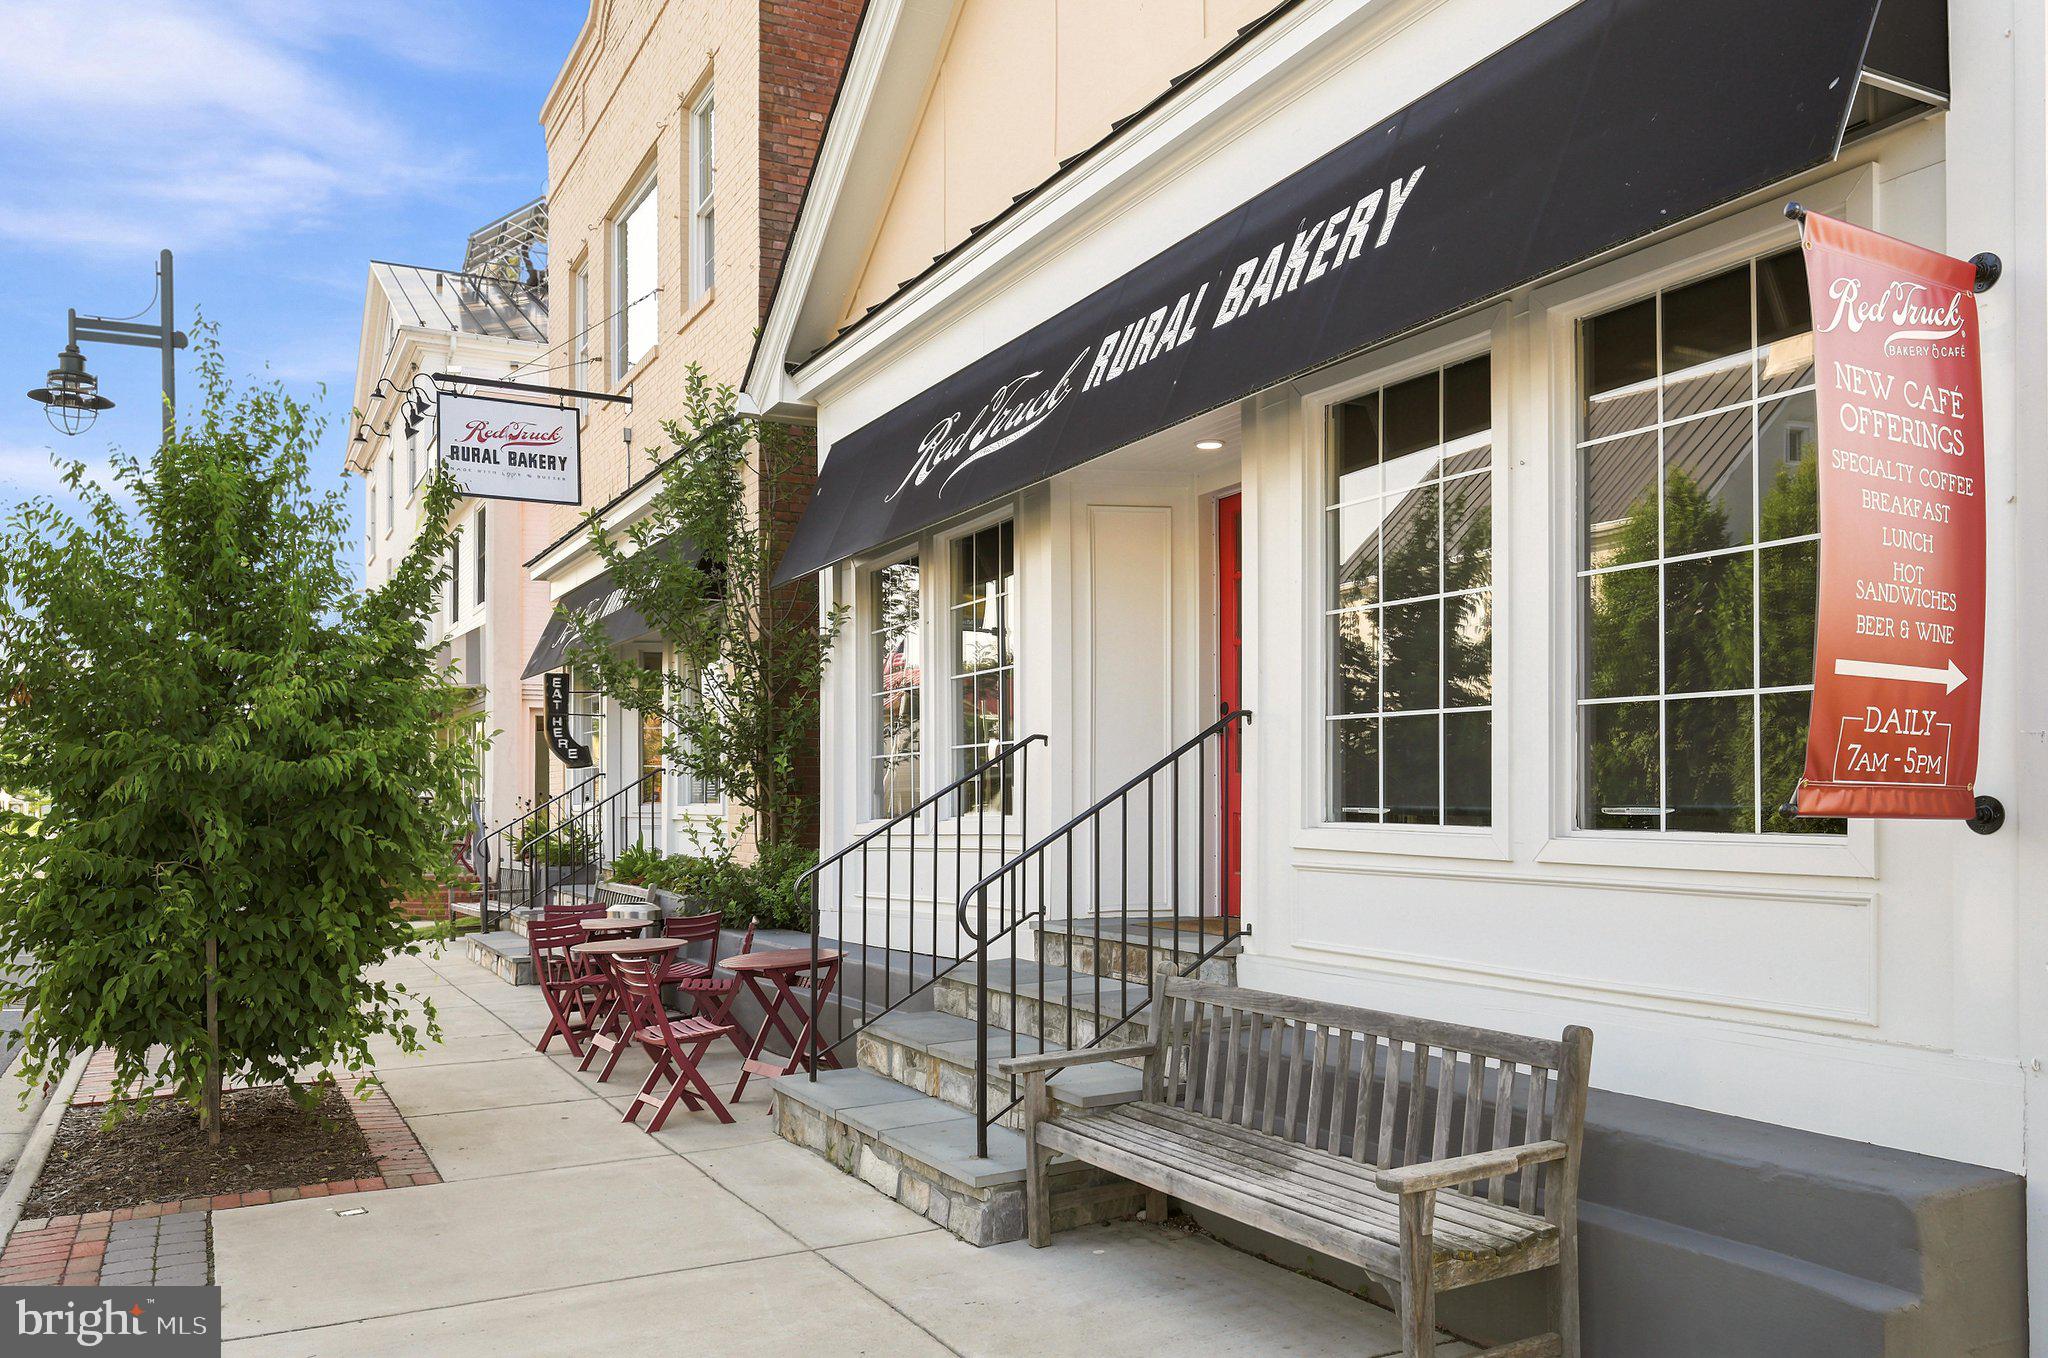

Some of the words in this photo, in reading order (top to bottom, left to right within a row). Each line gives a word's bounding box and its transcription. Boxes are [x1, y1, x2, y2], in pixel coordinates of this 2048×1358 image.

[1816, 277, 1890, 333] Red
[1887, 280, 1965, 340] Truck
[884, 409, 971, 503] Red
[962, 346, 1091, 462] Truck
[1082, 282, 1210, 393] RURAL
[1212, 165, 1427, 329] BAKERY
[1889, 346, 1928, 357] BAKERY
[1834, 361, 1895, 400] NEW
[1904, 381, 1965, 419] CAFÉ
[461, 419, 508, 443] Red
[503, 421, 563, 446] Truck
[1839, 403, 1965, 457] OFFERINGS
[450, 445, 500, 465] RURAL
[508, 451, 567, 471] BAKERY
[1832, 449, 1914, 483] SPECIALTY
[1919, 468, 1974, 496] COFFEE
[1862, 489, 1951, 524] BREAKFAST
[1882, 527, 1934, 553] LUNCH
[1893, 562, 1925, 585] HOT
[1855, 579, 1957, 613] SANDWICHES
[1856, 614, 1896, 639] BEER
[1900, 620, 1910, 640] &
[1916, 621, 1955, 645] WINE
[552, 677, 563, 711] EAT
[552, 716, 578, 759] HERE
[1864, 706, 1937, 737] DAILY
[1847, 743, 1889, 773] 7AM
[1904, 747, 1943, 775] 5PM
